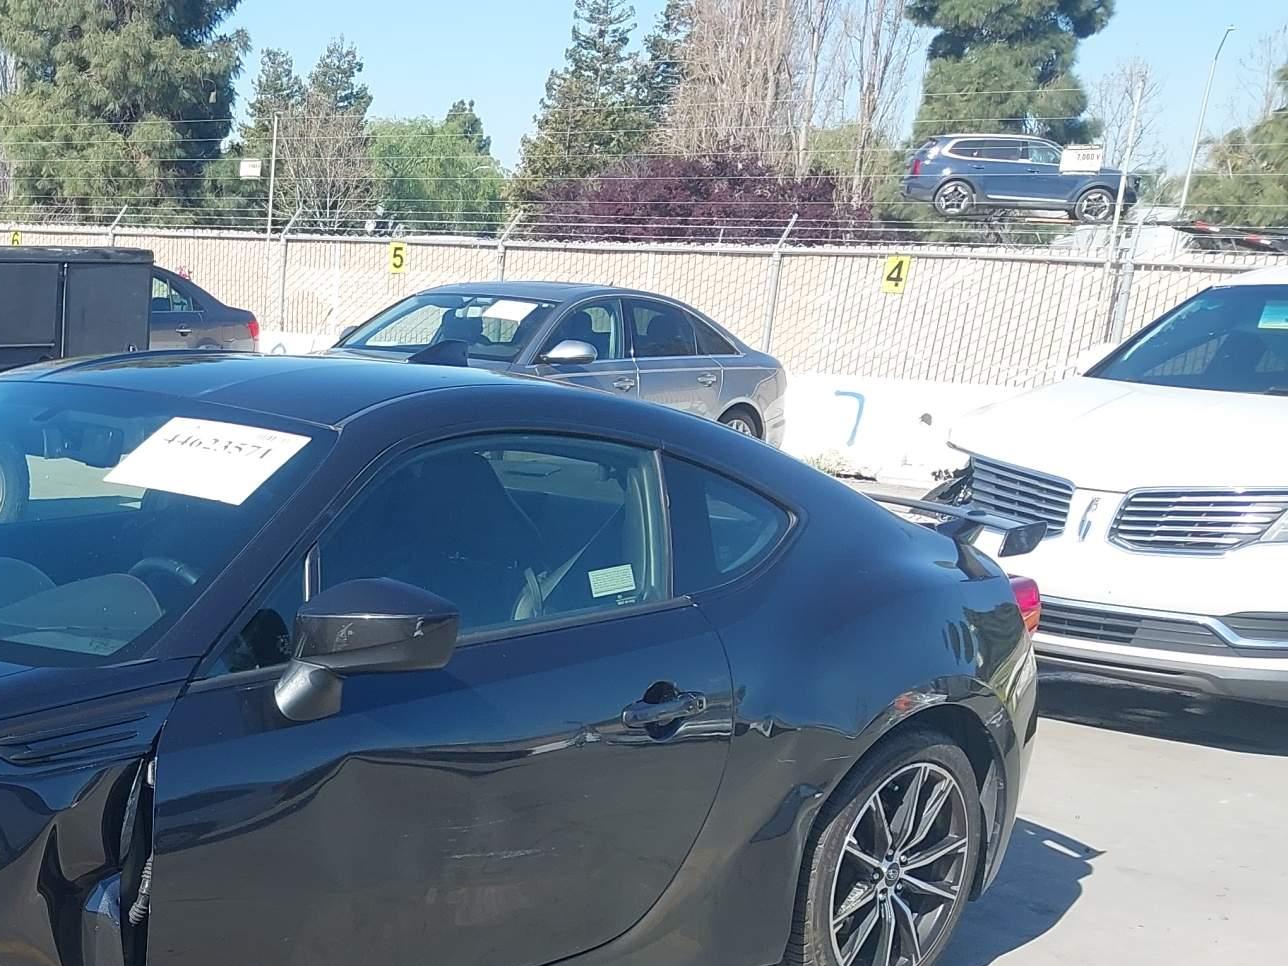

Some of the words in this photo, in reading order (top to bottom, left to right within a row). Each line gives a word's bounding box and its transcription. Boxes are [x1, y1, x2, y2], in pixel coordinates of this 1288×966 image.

[11, 231, 20, 246] 6
[393, 247, 404, 269] 5
[885, 260, 904, 287] 4
[163, 433, 273, 459] 44623571
